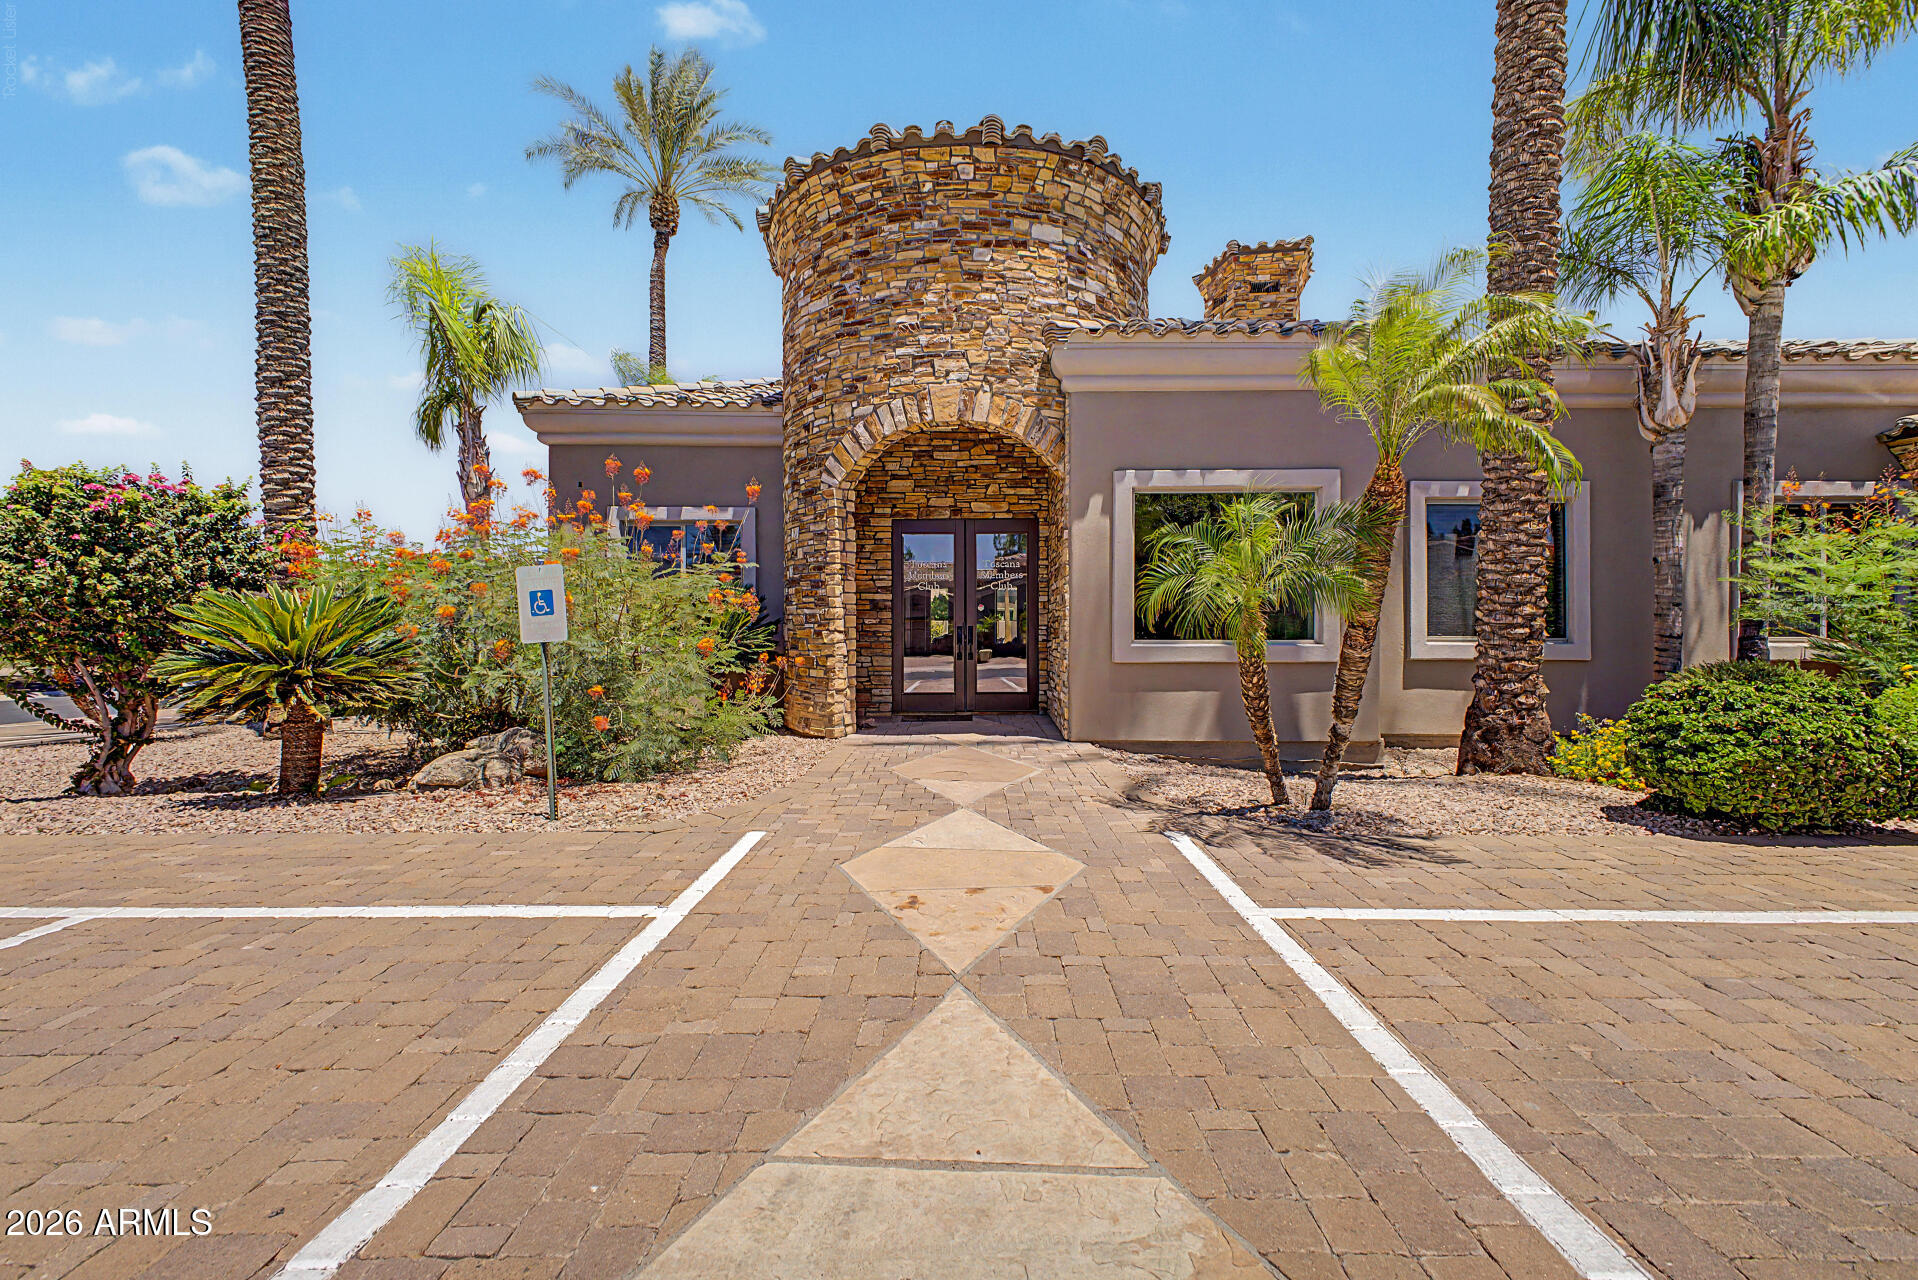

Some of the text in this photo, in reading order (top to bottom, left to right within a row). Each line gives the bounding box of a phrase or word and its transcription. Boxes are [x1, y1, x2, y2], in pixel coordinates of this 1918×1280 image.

[983, 559, 1020, 568] Toscana
[980, 570, 1023, 579] Members
[917, 581, 940, 590] Club
[990, 581, 1013, 590] Club
